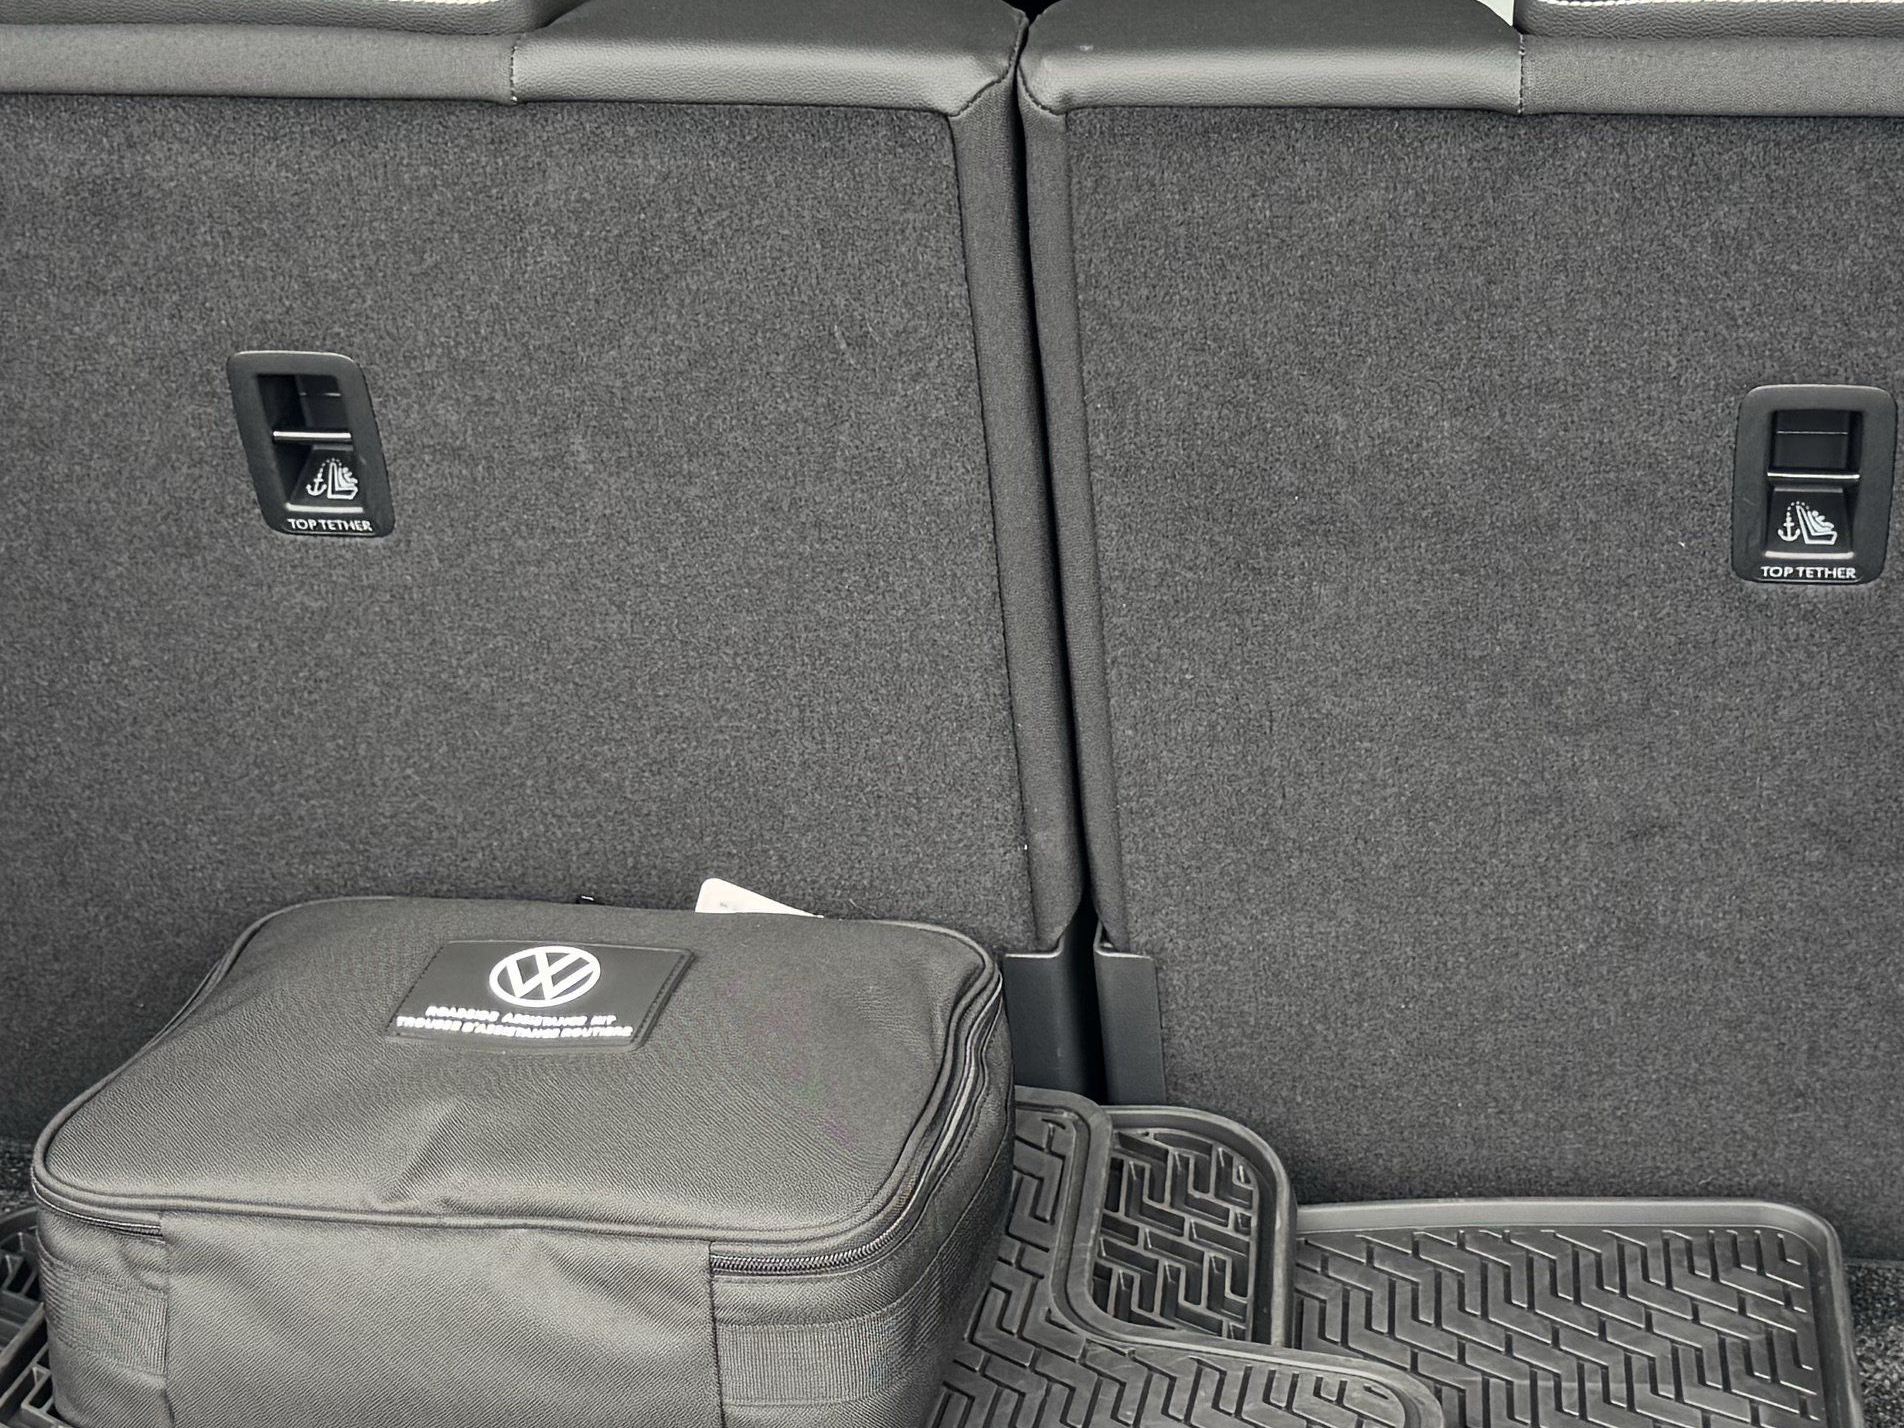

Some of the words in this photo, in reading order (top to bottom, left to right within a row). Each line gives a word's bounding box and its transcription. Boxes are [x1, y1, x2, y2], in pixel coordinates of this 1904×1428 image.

[287, 518, 317, 530] TOP
[319, 518, 373, 532] TETHER
[1760, 565, 1793, 578] TOP
[1796, 566, 1856, 579] TETHER
[396, 1015, 462, 1031] TROUSSE
[425, 1005, 499, 1022] ROADSIDE
[501, 1012, 588, 1026] ASSISTANCE
